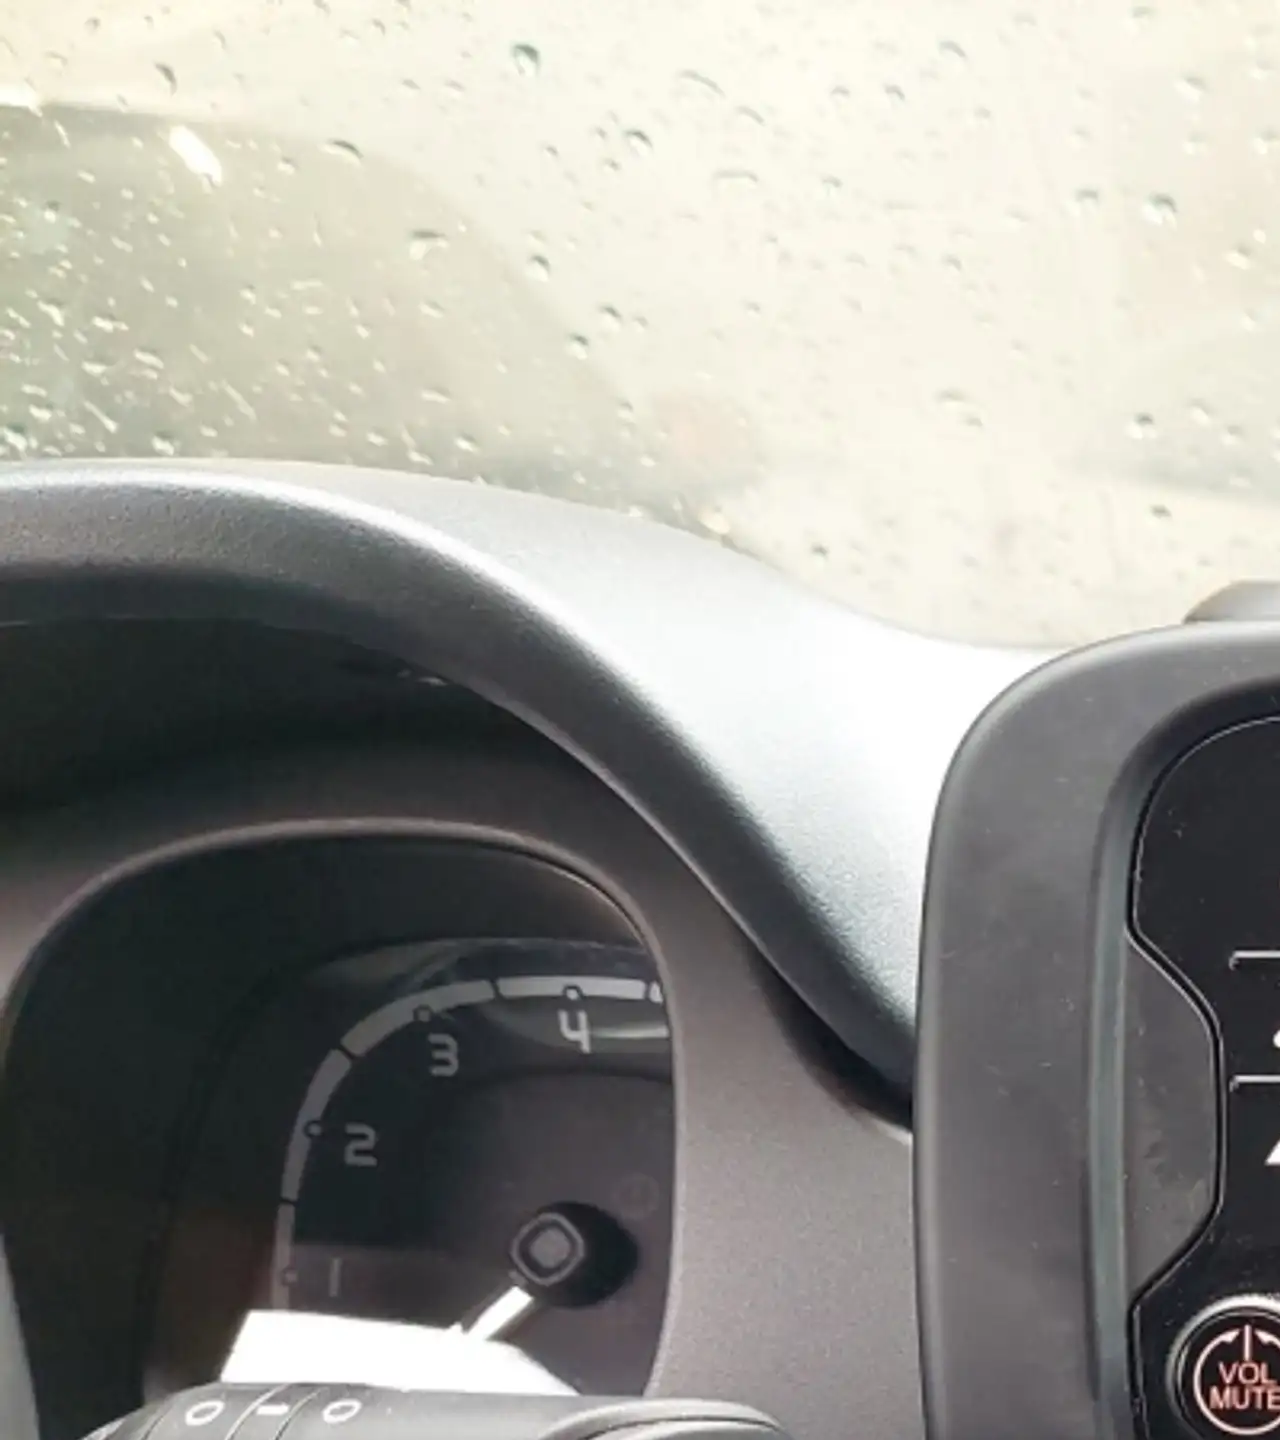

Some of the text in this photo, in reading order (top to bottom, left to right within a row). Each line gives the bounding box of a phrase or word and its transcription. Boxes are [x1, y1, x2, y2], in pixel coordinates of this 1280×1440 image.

[558, 1009, 591, 1053] 4
[428, 1033, 459, 1076] 3
[344, 1123, 378, 1167] 2
[1219, 1361, 1276, 1387] VOL
